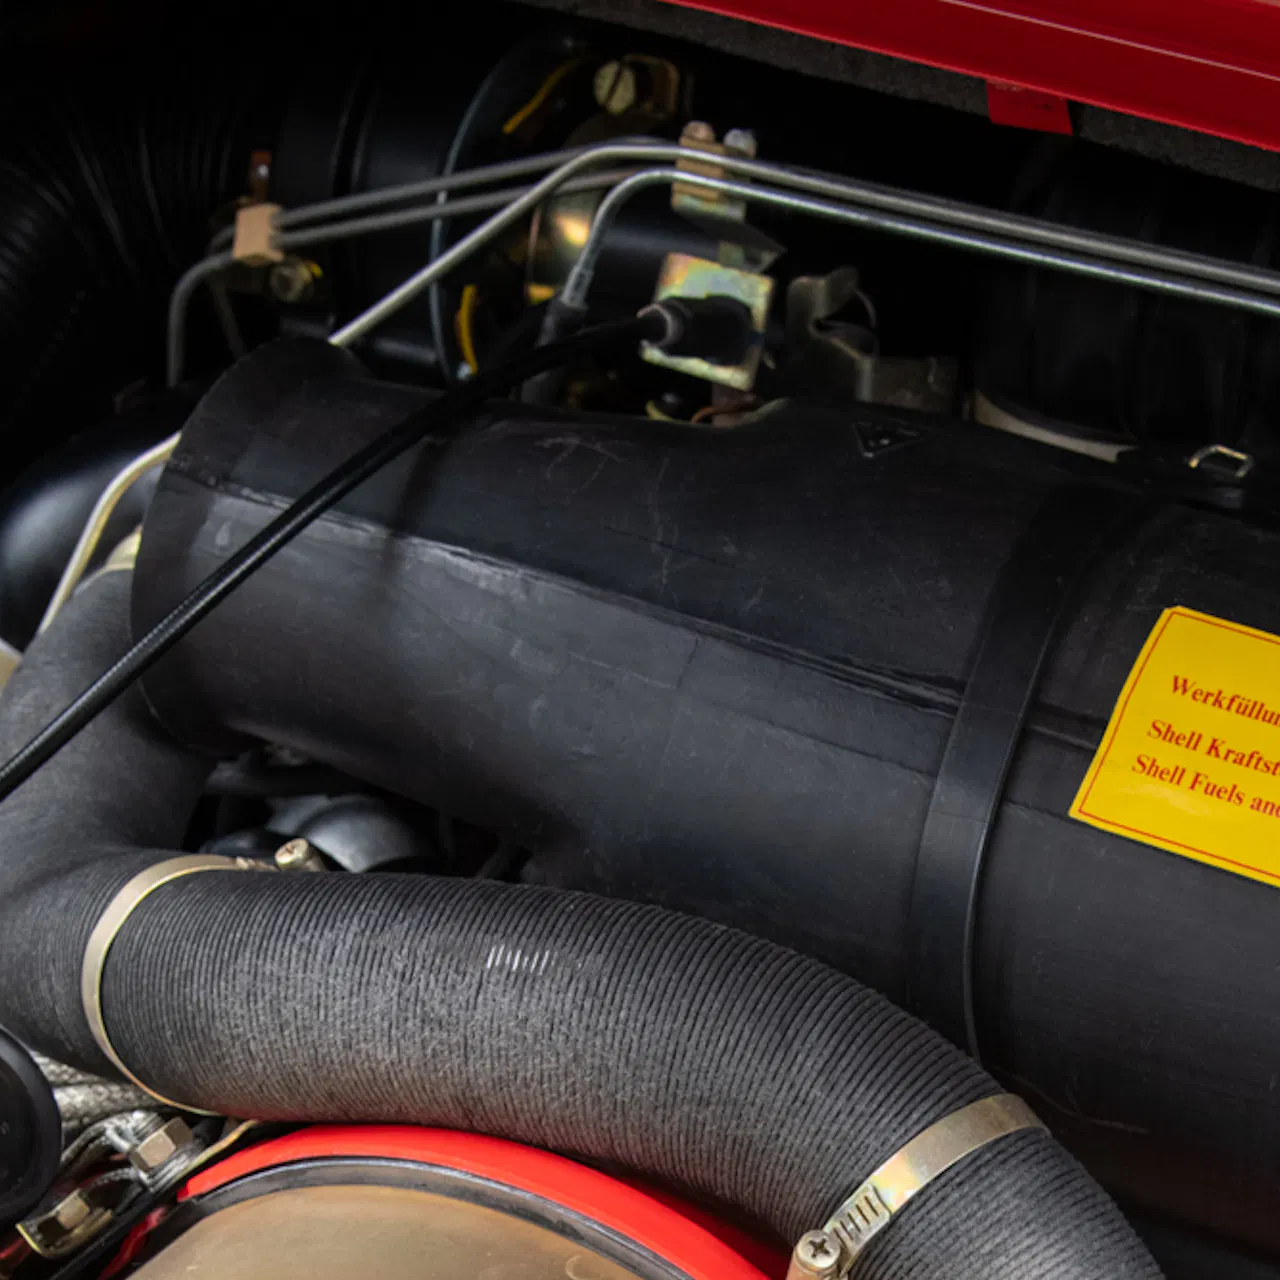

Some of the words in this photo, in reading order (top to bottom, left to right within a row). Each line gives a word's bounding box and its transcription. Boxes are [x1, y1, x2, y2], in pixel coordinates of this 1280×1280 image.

[1147, 720, 1203, 751] Shell
[1132, 755, 1186, 785] Shell
[1189, 772, 1244, 804] Fuels
